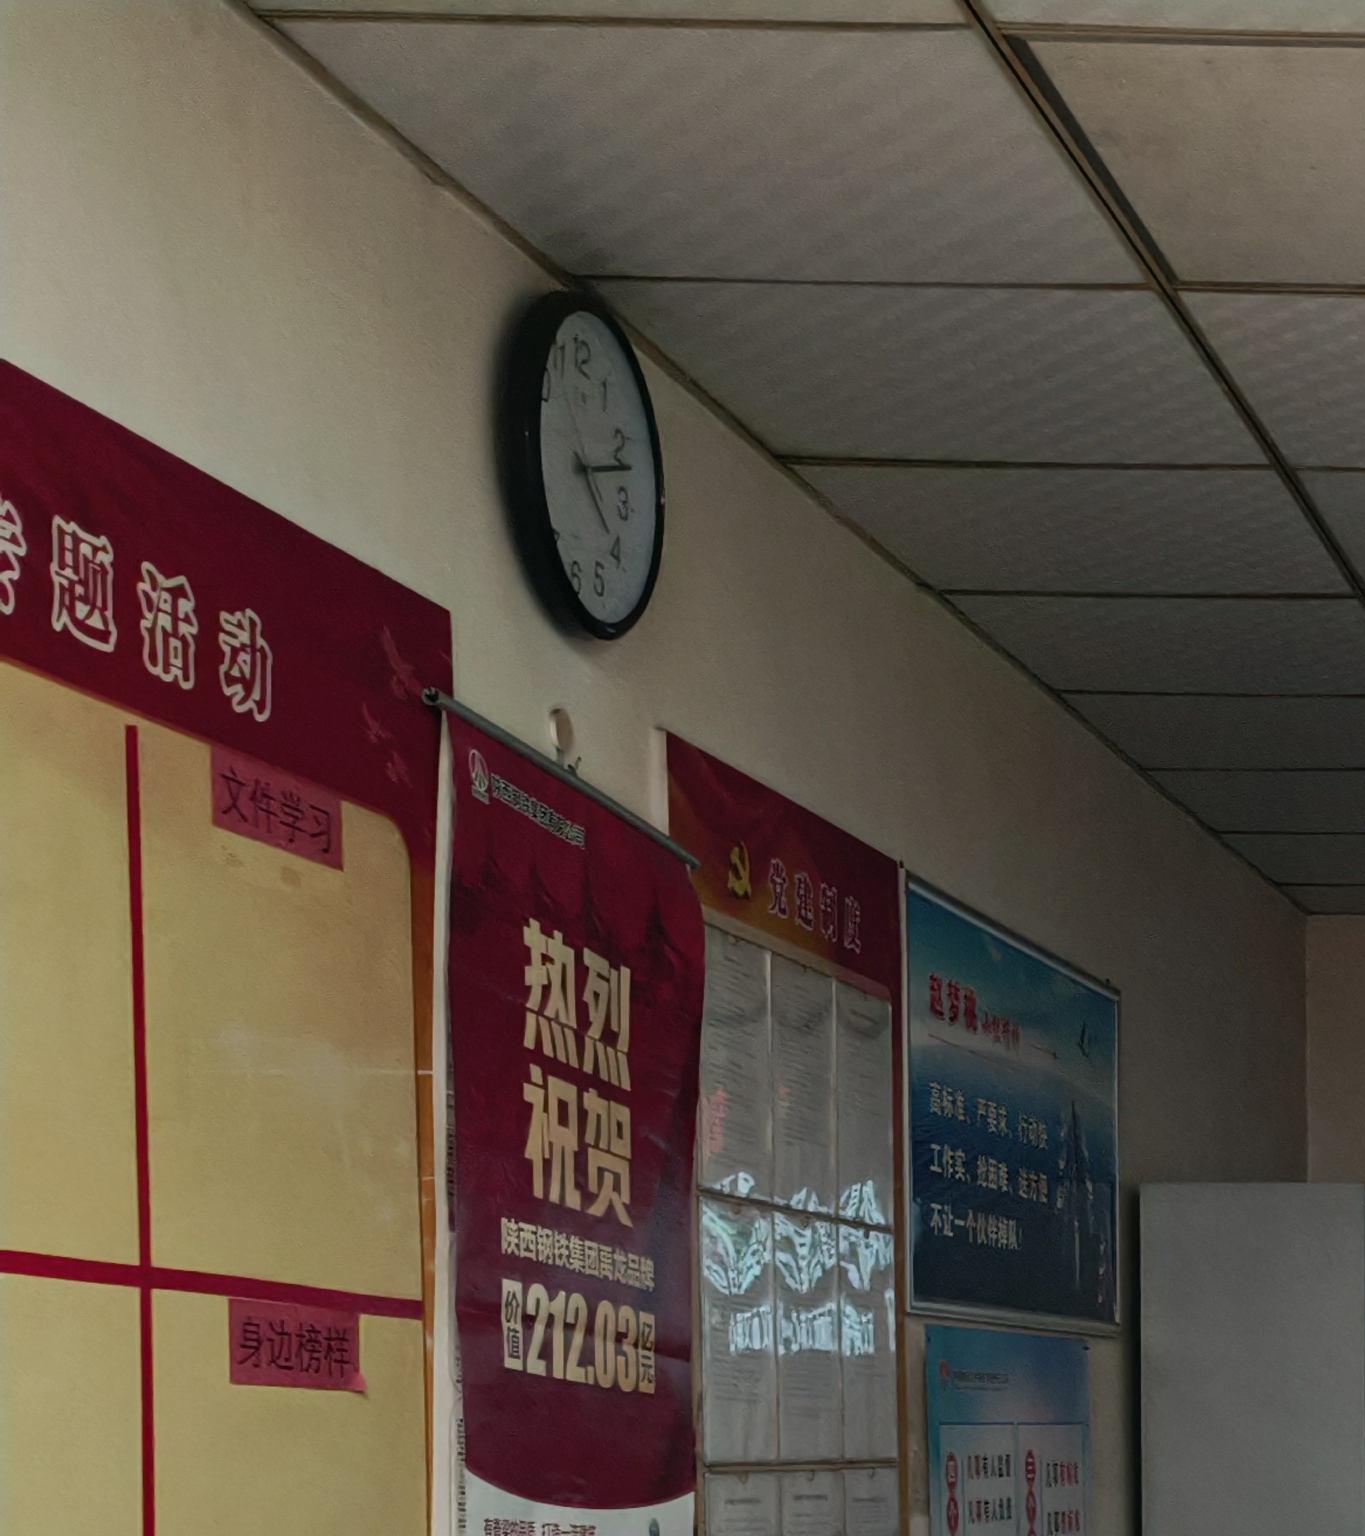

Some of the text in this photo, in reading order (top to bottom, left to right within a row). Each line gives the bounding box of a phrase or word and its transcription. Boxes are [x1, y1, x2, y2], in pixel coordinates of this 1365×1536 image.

[616, 485, 630, 522] 3
[593, 560, 606, 598] 5
[609, 535, 622, 565] 4
[219, 766, 332, 853] 文件学习
[768, 857, 861, 954] 党建制度
[522, 918, 633, 1091] 热烈
[522, 1063, 634, 1228] 祝贺
[500, 1217, 656, 1292] 陕西钢铁集团禹龙品牌
[236, 1317, 351, 1378] 身边榜样
[504, 1289, 521, 1360] 价值
[526, 1283, 638, 1392] 212.03
[641, 1322, 654, 1384] 亿元
